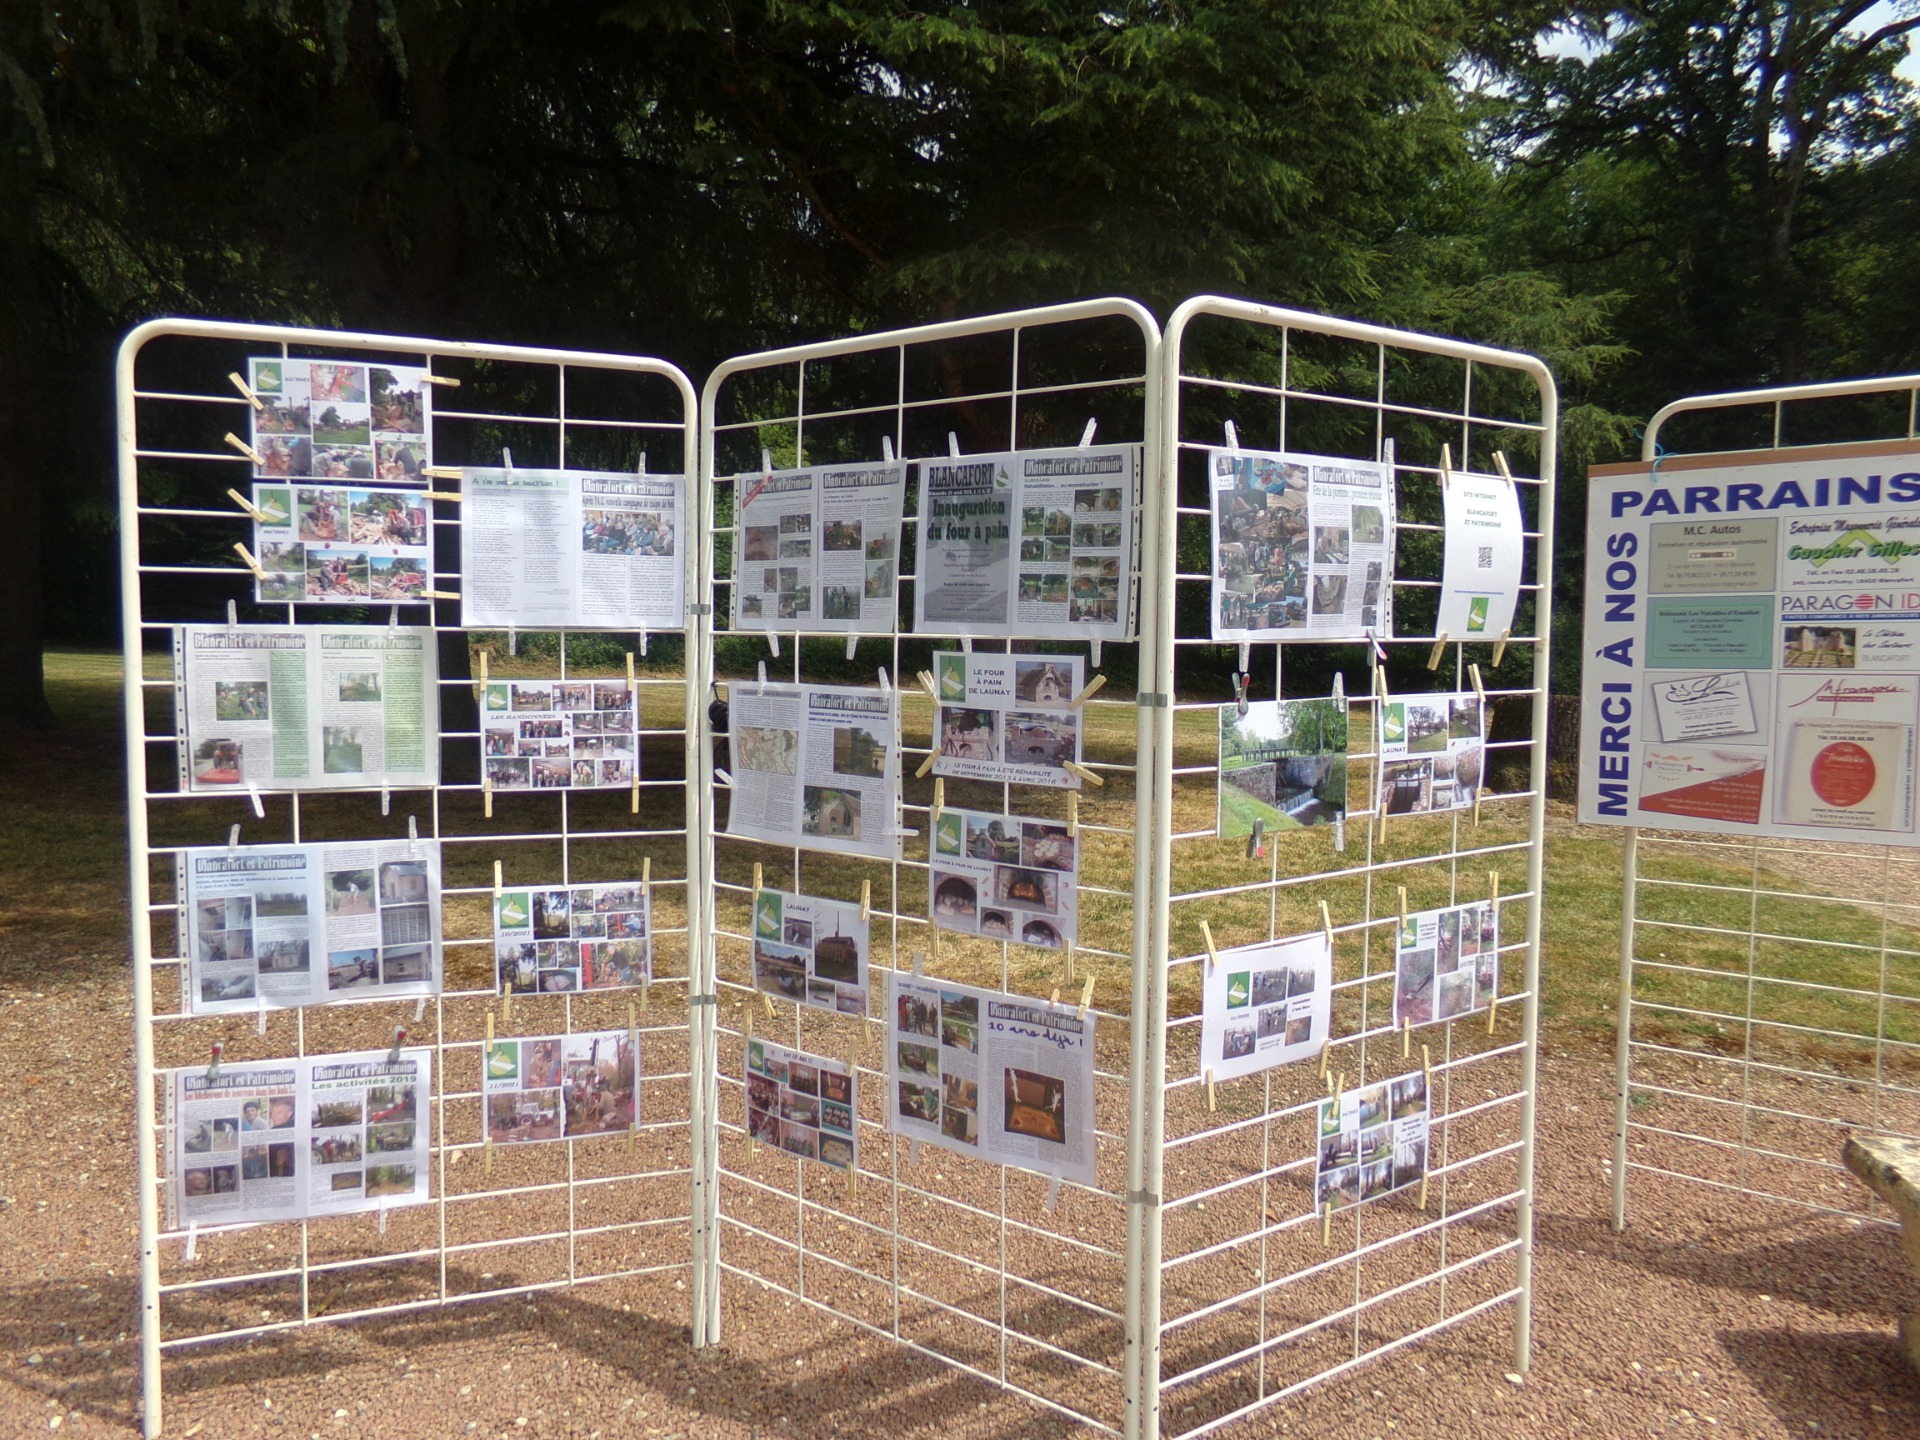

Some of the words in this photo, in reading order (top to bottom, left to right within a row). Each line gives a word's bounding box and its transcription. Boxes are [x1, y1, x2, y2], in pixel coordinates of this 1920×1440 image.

[1026, 459, 1067, 475] Blancafort
[1079, 456, 1122, 473] Patrimoine
[928, 462, 995, 488] BLANCAFORT
[1474, 492, 1497, 501] INTERNET
[1611, 472, 1920, 518] PARRAINS
[932, 495, 1006, 522] Inauguration
[1466, 508, 1498, 517] BLANCAFORT
[927, 521, 942, 541] du
[946, 521, 971, 541] four
[974, 520, 982, 540] à
[984, 520, 1010, 544] pain
[1471, 519, 1502, 529] PATRIMOINE
[1683, 526, 1706, 535] M.C.
[1710, 525, 1741, 535] Autos
[1789, 520, 1832, 535] Entreprise
[1787, 542, 1864, 561] Gaucher
[1867, 540, 1920, 558] Gilles
[1604, 531, 1639, 622] NOS
[1781, 593, 1894, 611] PARAGON
[1901, 593, 1920, 609] ID
[1596, 637, 1634, 668] À
[976, 676, 984, 685] À
[984, 669, 1005, 677] FOUR
[968, 687, 979, 695] DE
[979, 688, 1011, 696] LAUNAY
[1383, 745, 1407, 754] LAUNAY
[1598, 683, 1632, 817] MERCI
[961, 763, 977, 771] FOUR
[786, 903, 811, 913] LAUNAY
[989, 1001, 1030, 1022] Blancafort
[1040, 1009, 1084, 1034] Patrimoine
[988, 1021, 1005, 1032] 10
[1008, 1026, 1041, 1038] ans
[311, 1081, 332, 1090] Les
[335, 1076, 386, 1088] activités
[389, 1075, 417, 1084] 2019
